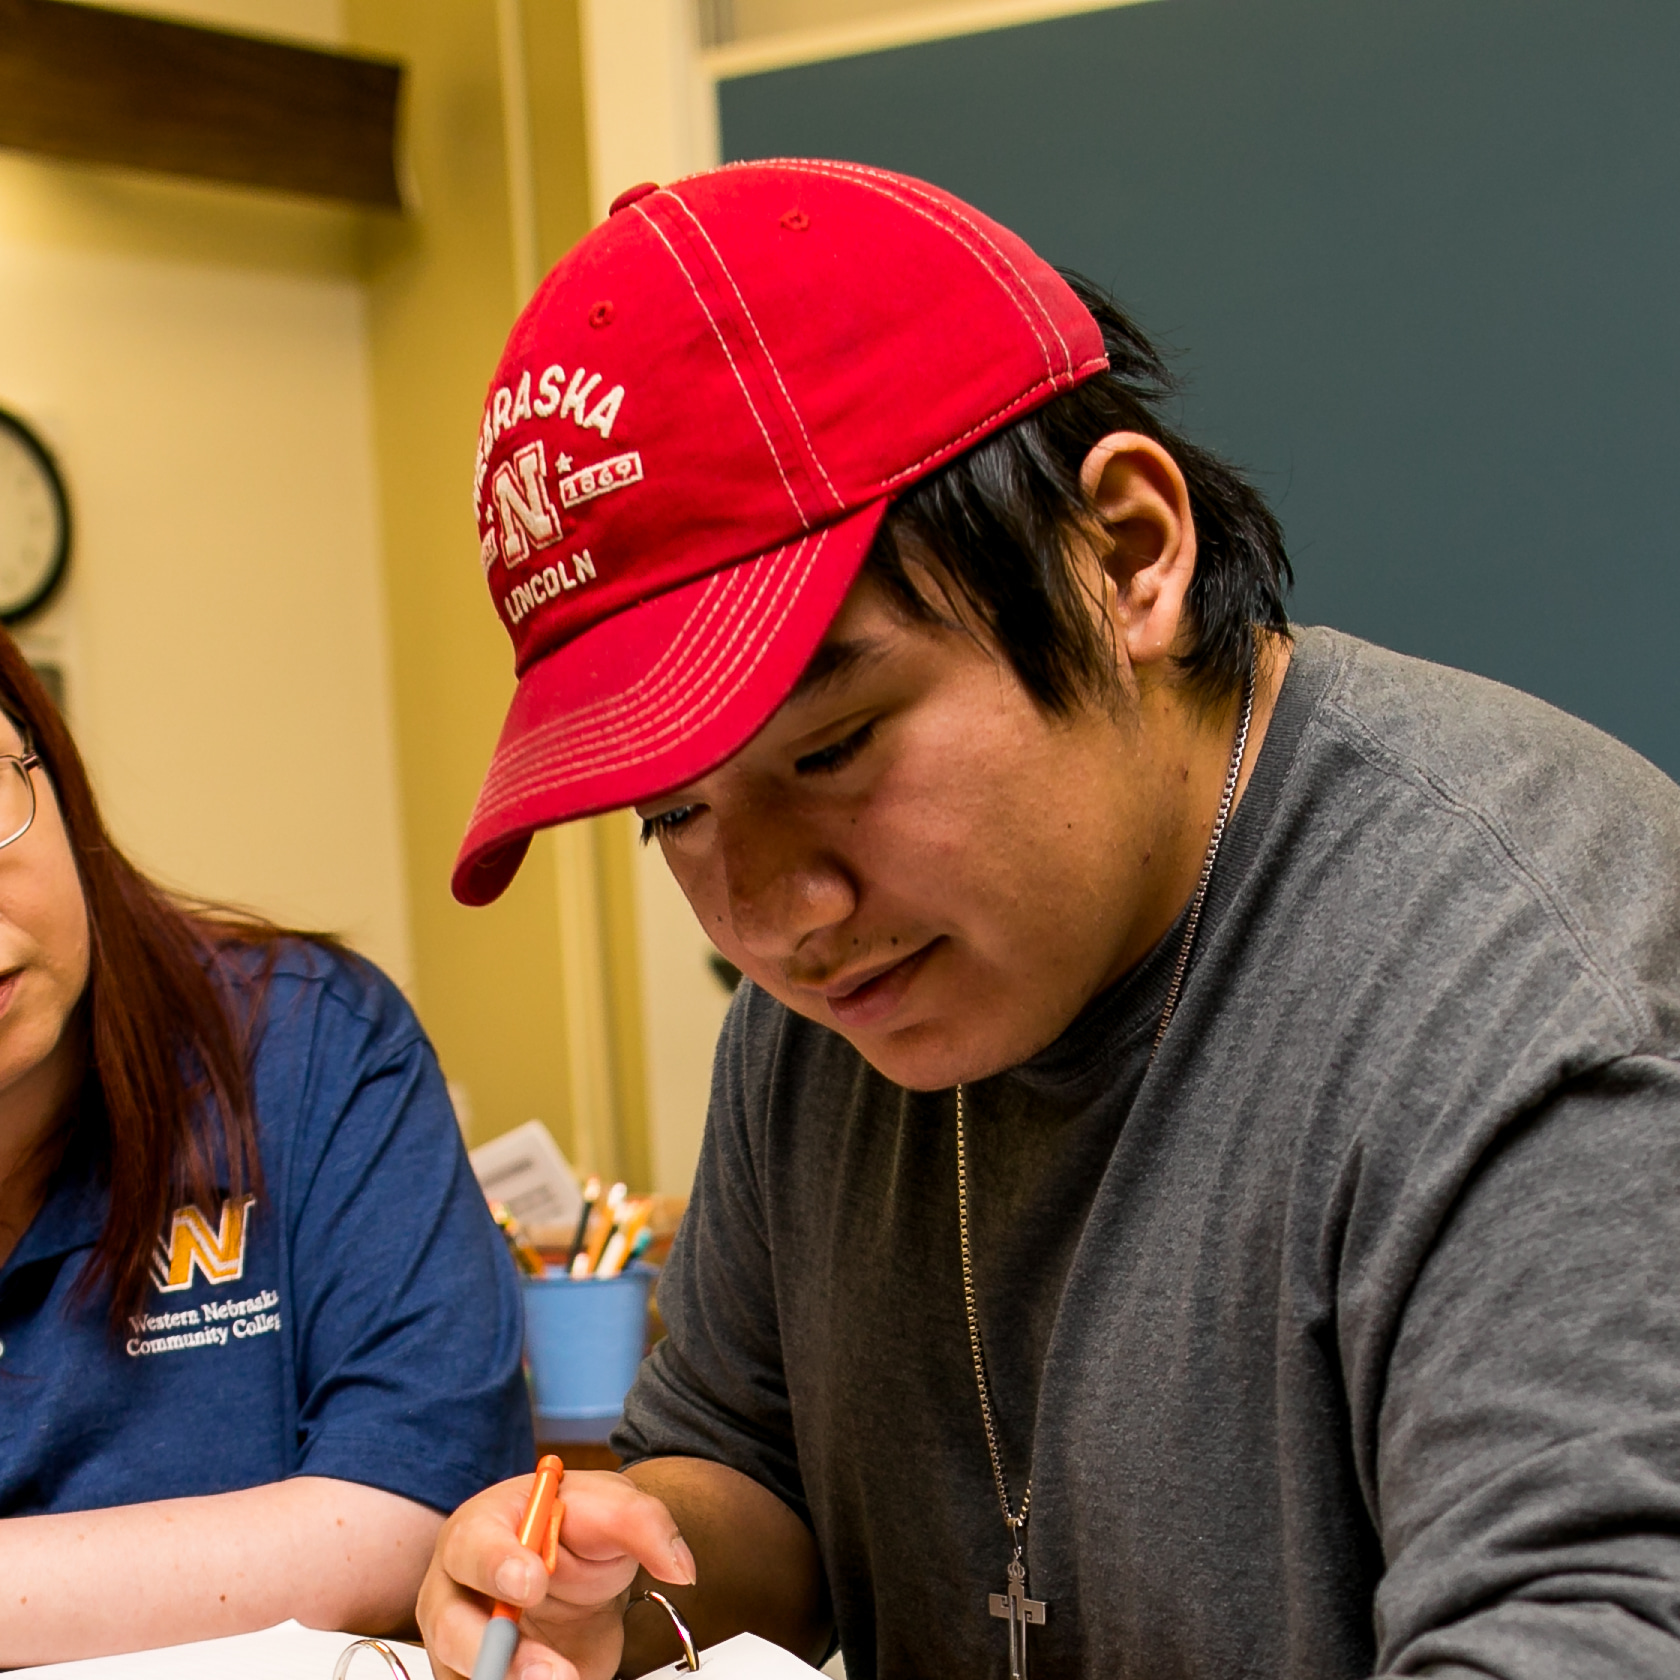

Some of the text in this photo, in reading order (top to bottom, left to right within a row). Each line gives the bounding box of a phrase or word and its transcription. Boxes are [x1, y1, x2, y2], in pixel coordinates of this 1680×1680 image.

[492, 440, 564, 569] N
[565, 460, 632, 499] 1869
[504, 548, 597, 625] LINCOLN
[126, 1312, 281, 1357] Community Colleg
[128, 1309, 201, 1333] Western
